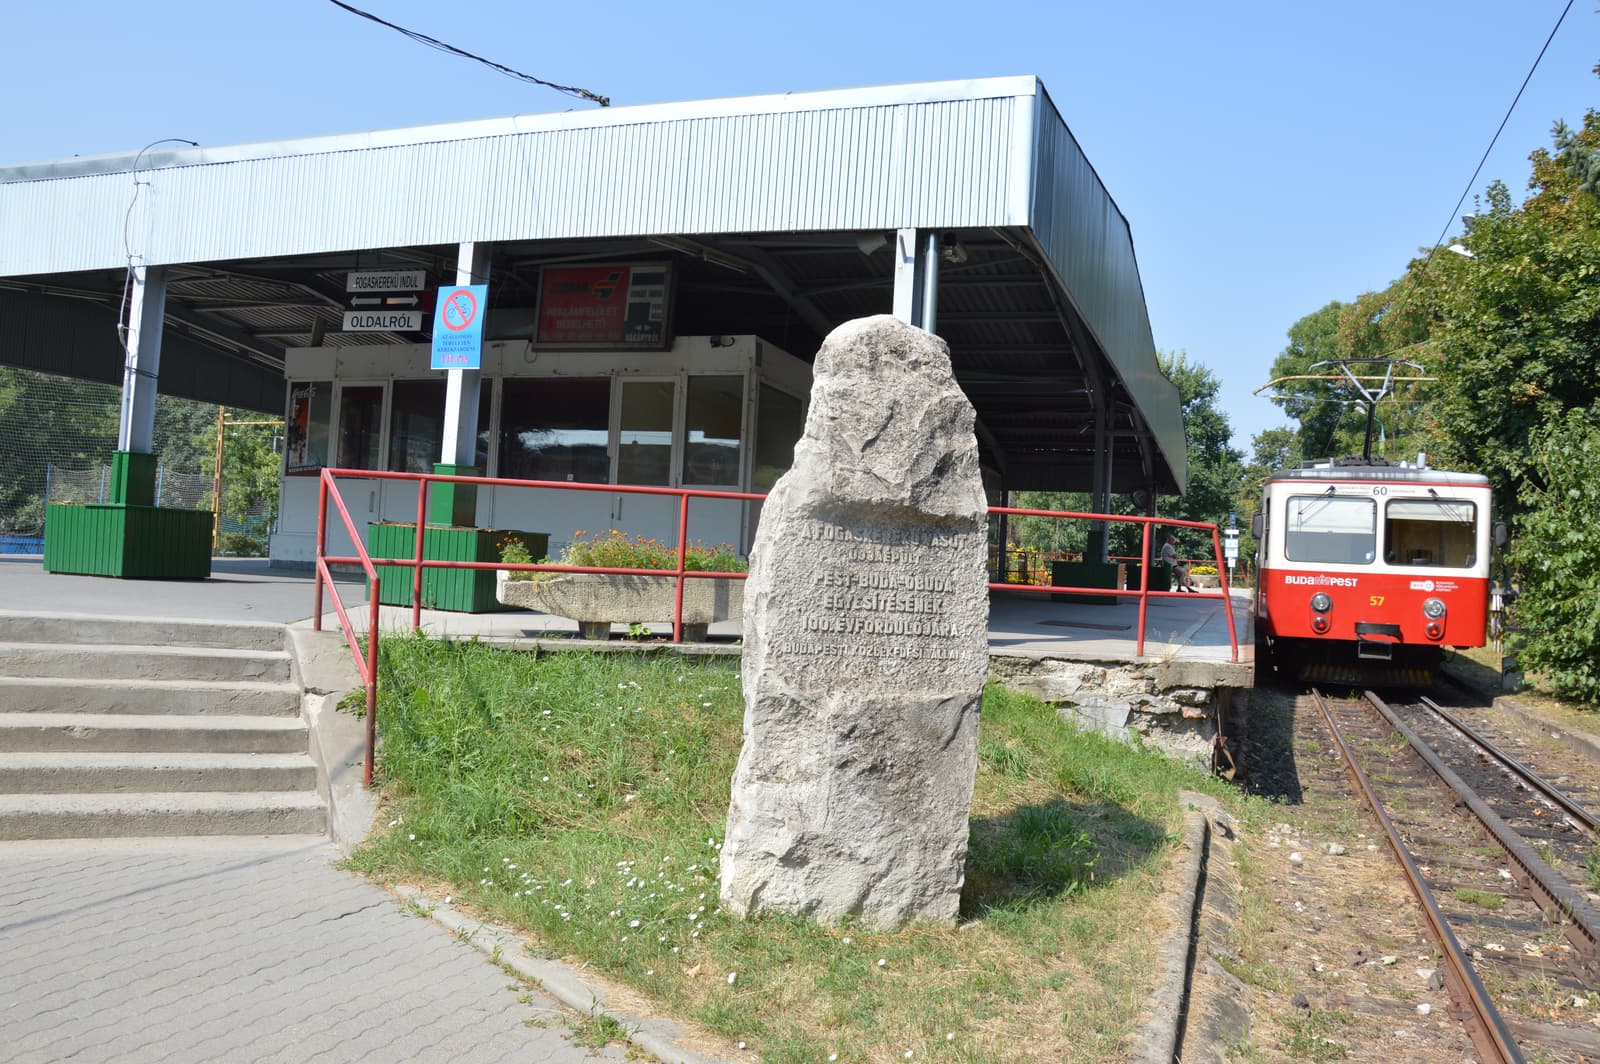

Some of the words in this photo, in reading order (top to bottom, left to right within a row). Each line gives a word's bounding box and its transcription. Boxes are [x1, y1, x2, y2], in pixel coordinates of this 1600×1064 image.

[399, 275, 419, 288] INDUL
[350, 313, 413, 329] OLDALRÓL
[1372, 486, 1388, 496] 60
[801, 522, 812, 539] A
[1369, 596, 1385, 606] 57
